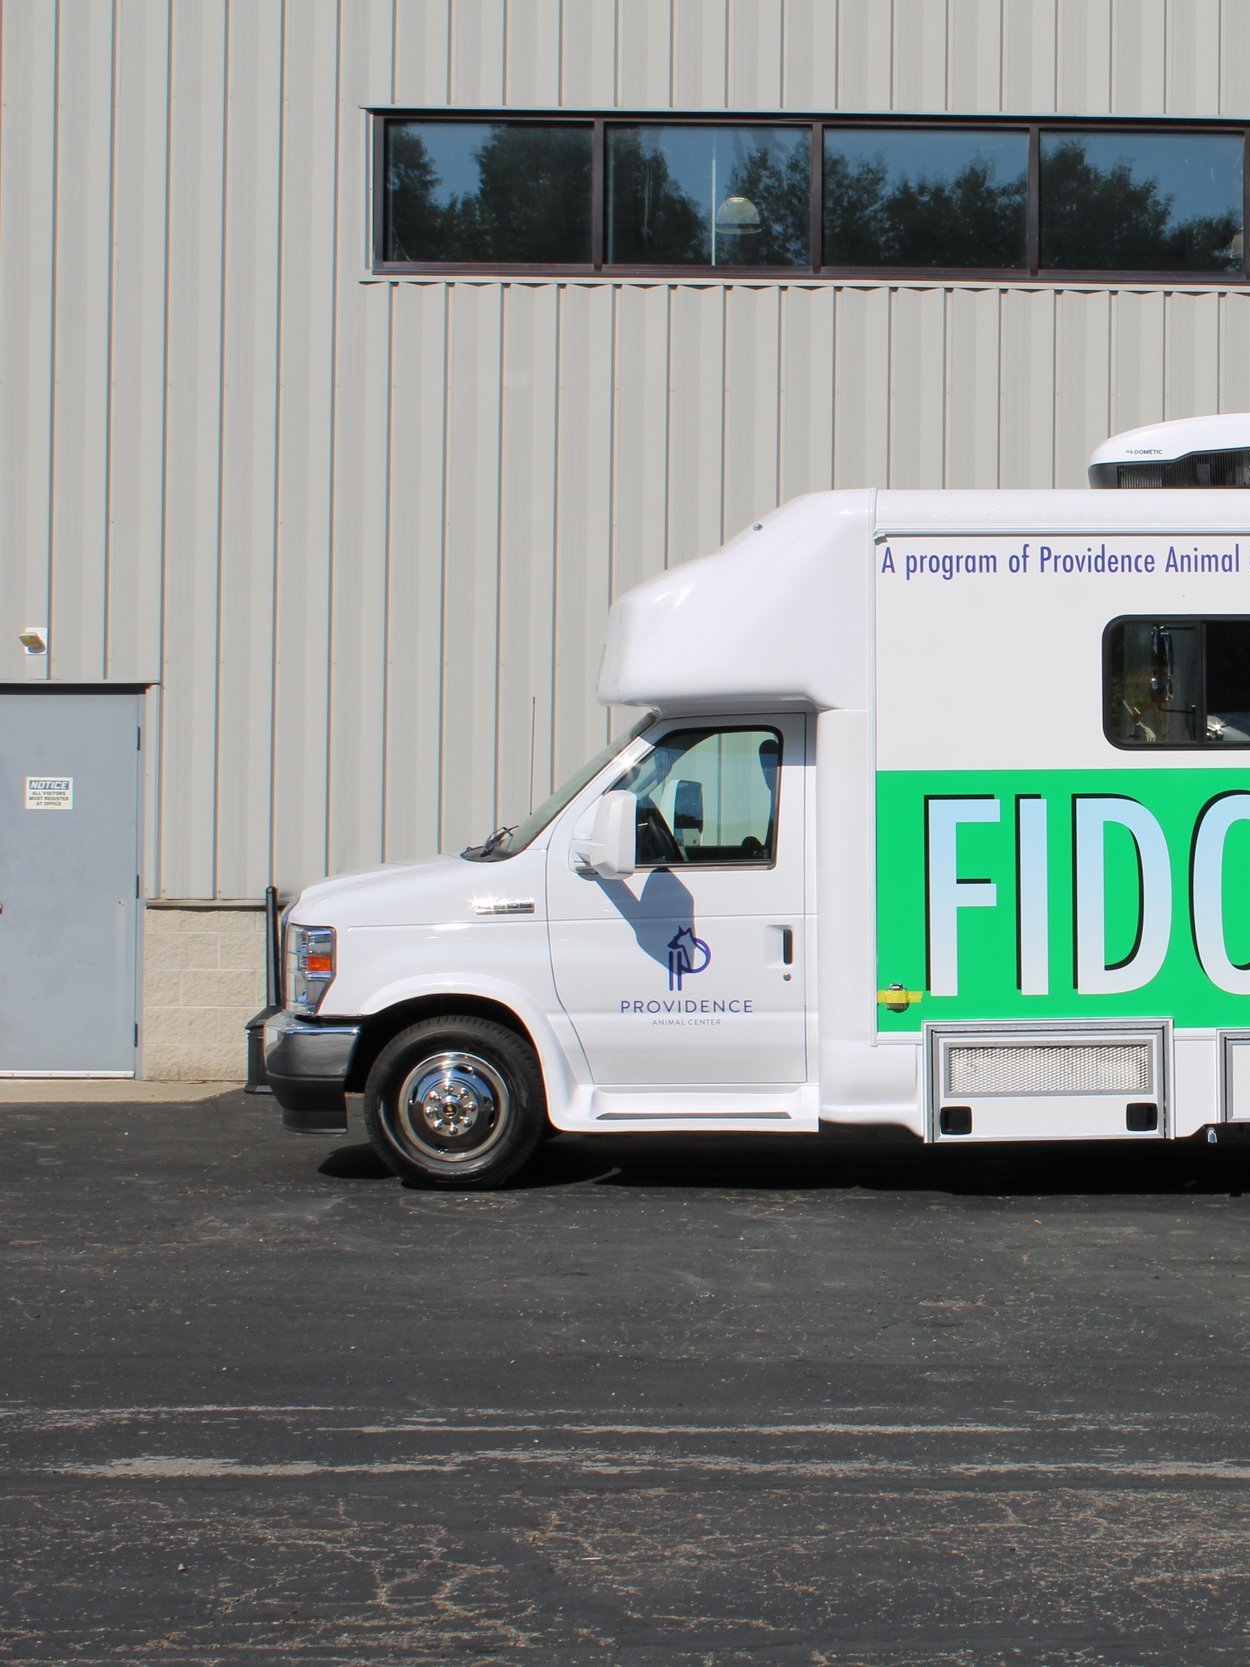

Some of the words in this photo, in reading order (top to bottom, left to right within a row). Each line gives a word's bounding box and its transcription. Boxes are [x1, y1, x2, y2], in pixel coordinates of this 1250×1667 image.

[881, 546, 896, 574] A
[905, 552, 998, 580] program
[1008, 543, 1030, 574] of
[1039, 543, 1156, 574] Providence
[1164, 544, 1240, 573] Animal
[30, 781, 69, 789] NOTICE
[620, 999, 753, 1014] PROVIDENCE
